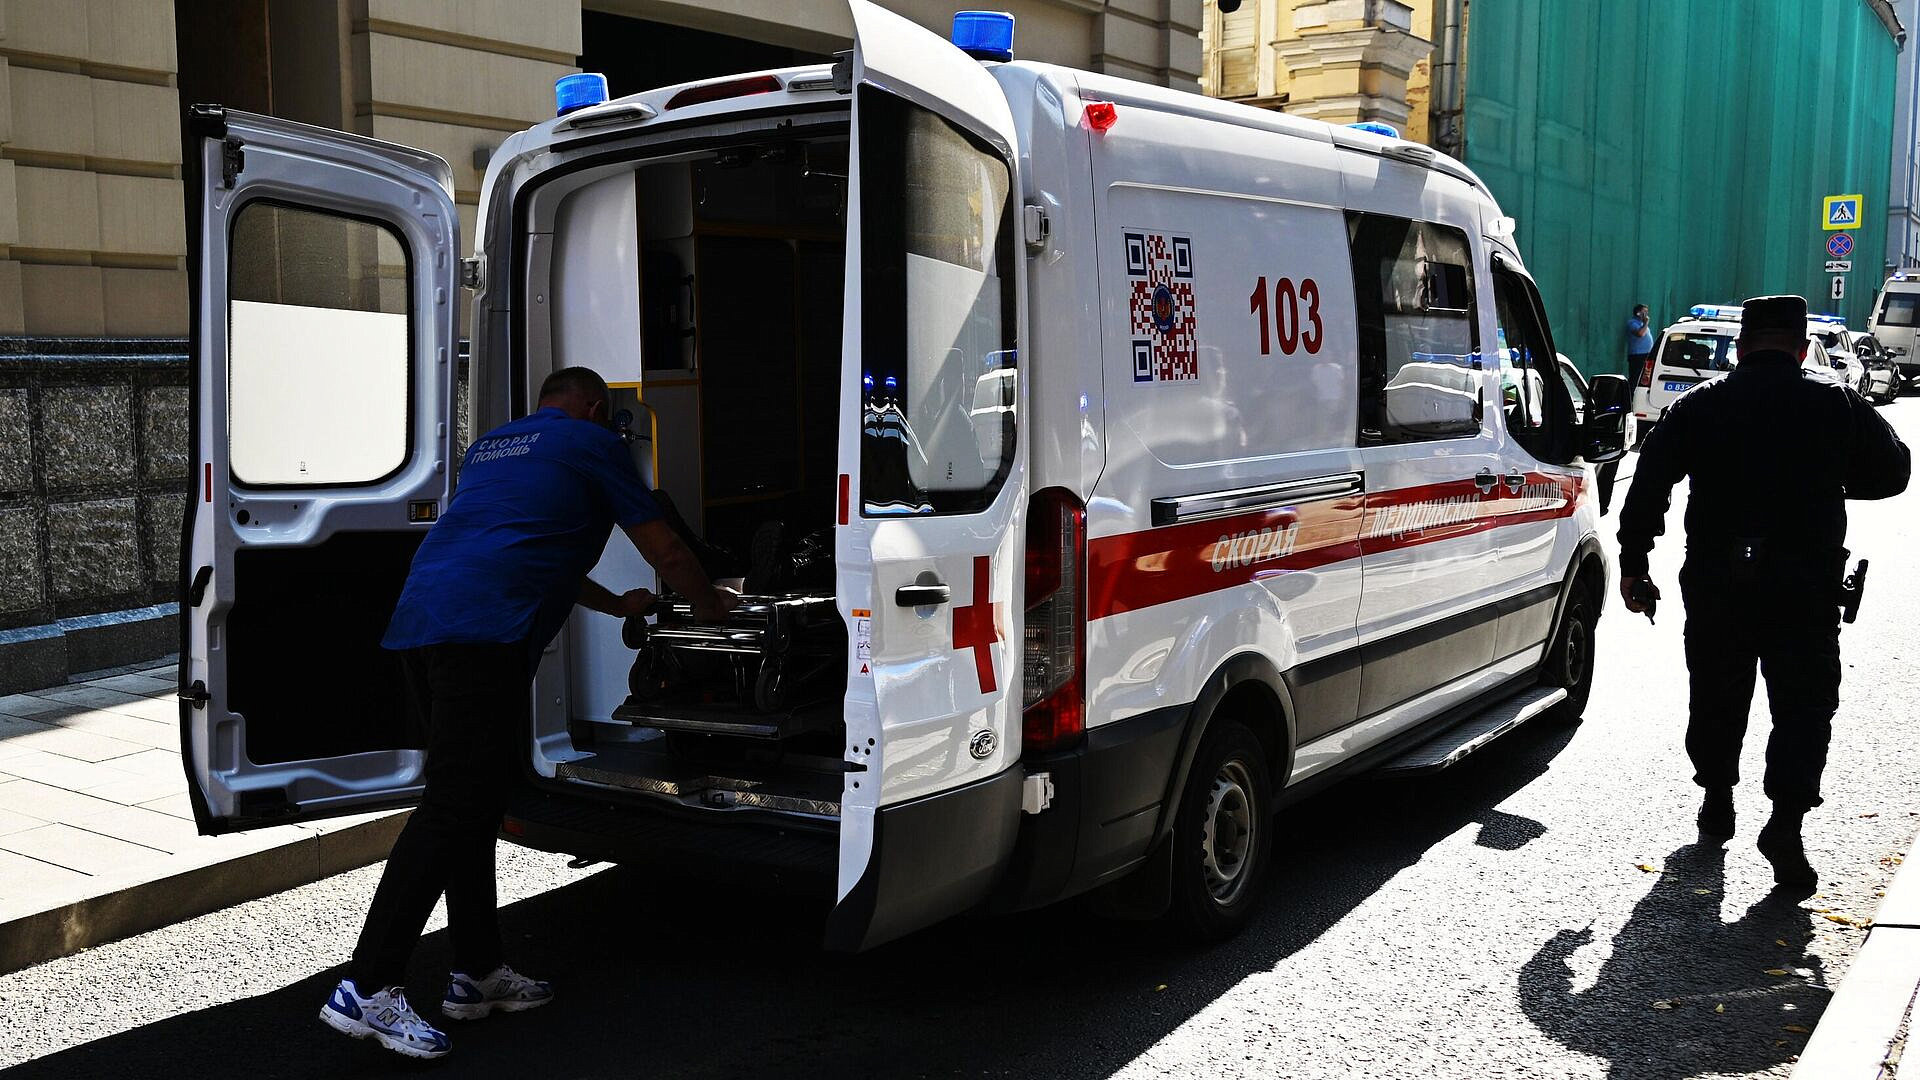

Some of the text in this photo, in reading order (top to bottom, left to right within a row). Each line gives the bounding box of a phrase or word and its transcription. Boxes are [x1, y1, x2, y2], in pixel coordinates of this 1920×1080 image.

[1250, 276, 1323, 356] 103
[471, 444, 531, 465] ПОМОЩЬ
[479, 432, 541, 451] СКОРАЯ
[1211, 521, 1299, 573] СКОРАЯ
[1369, 492, 1480, 542] МЕДИЦИНСКАЯ
